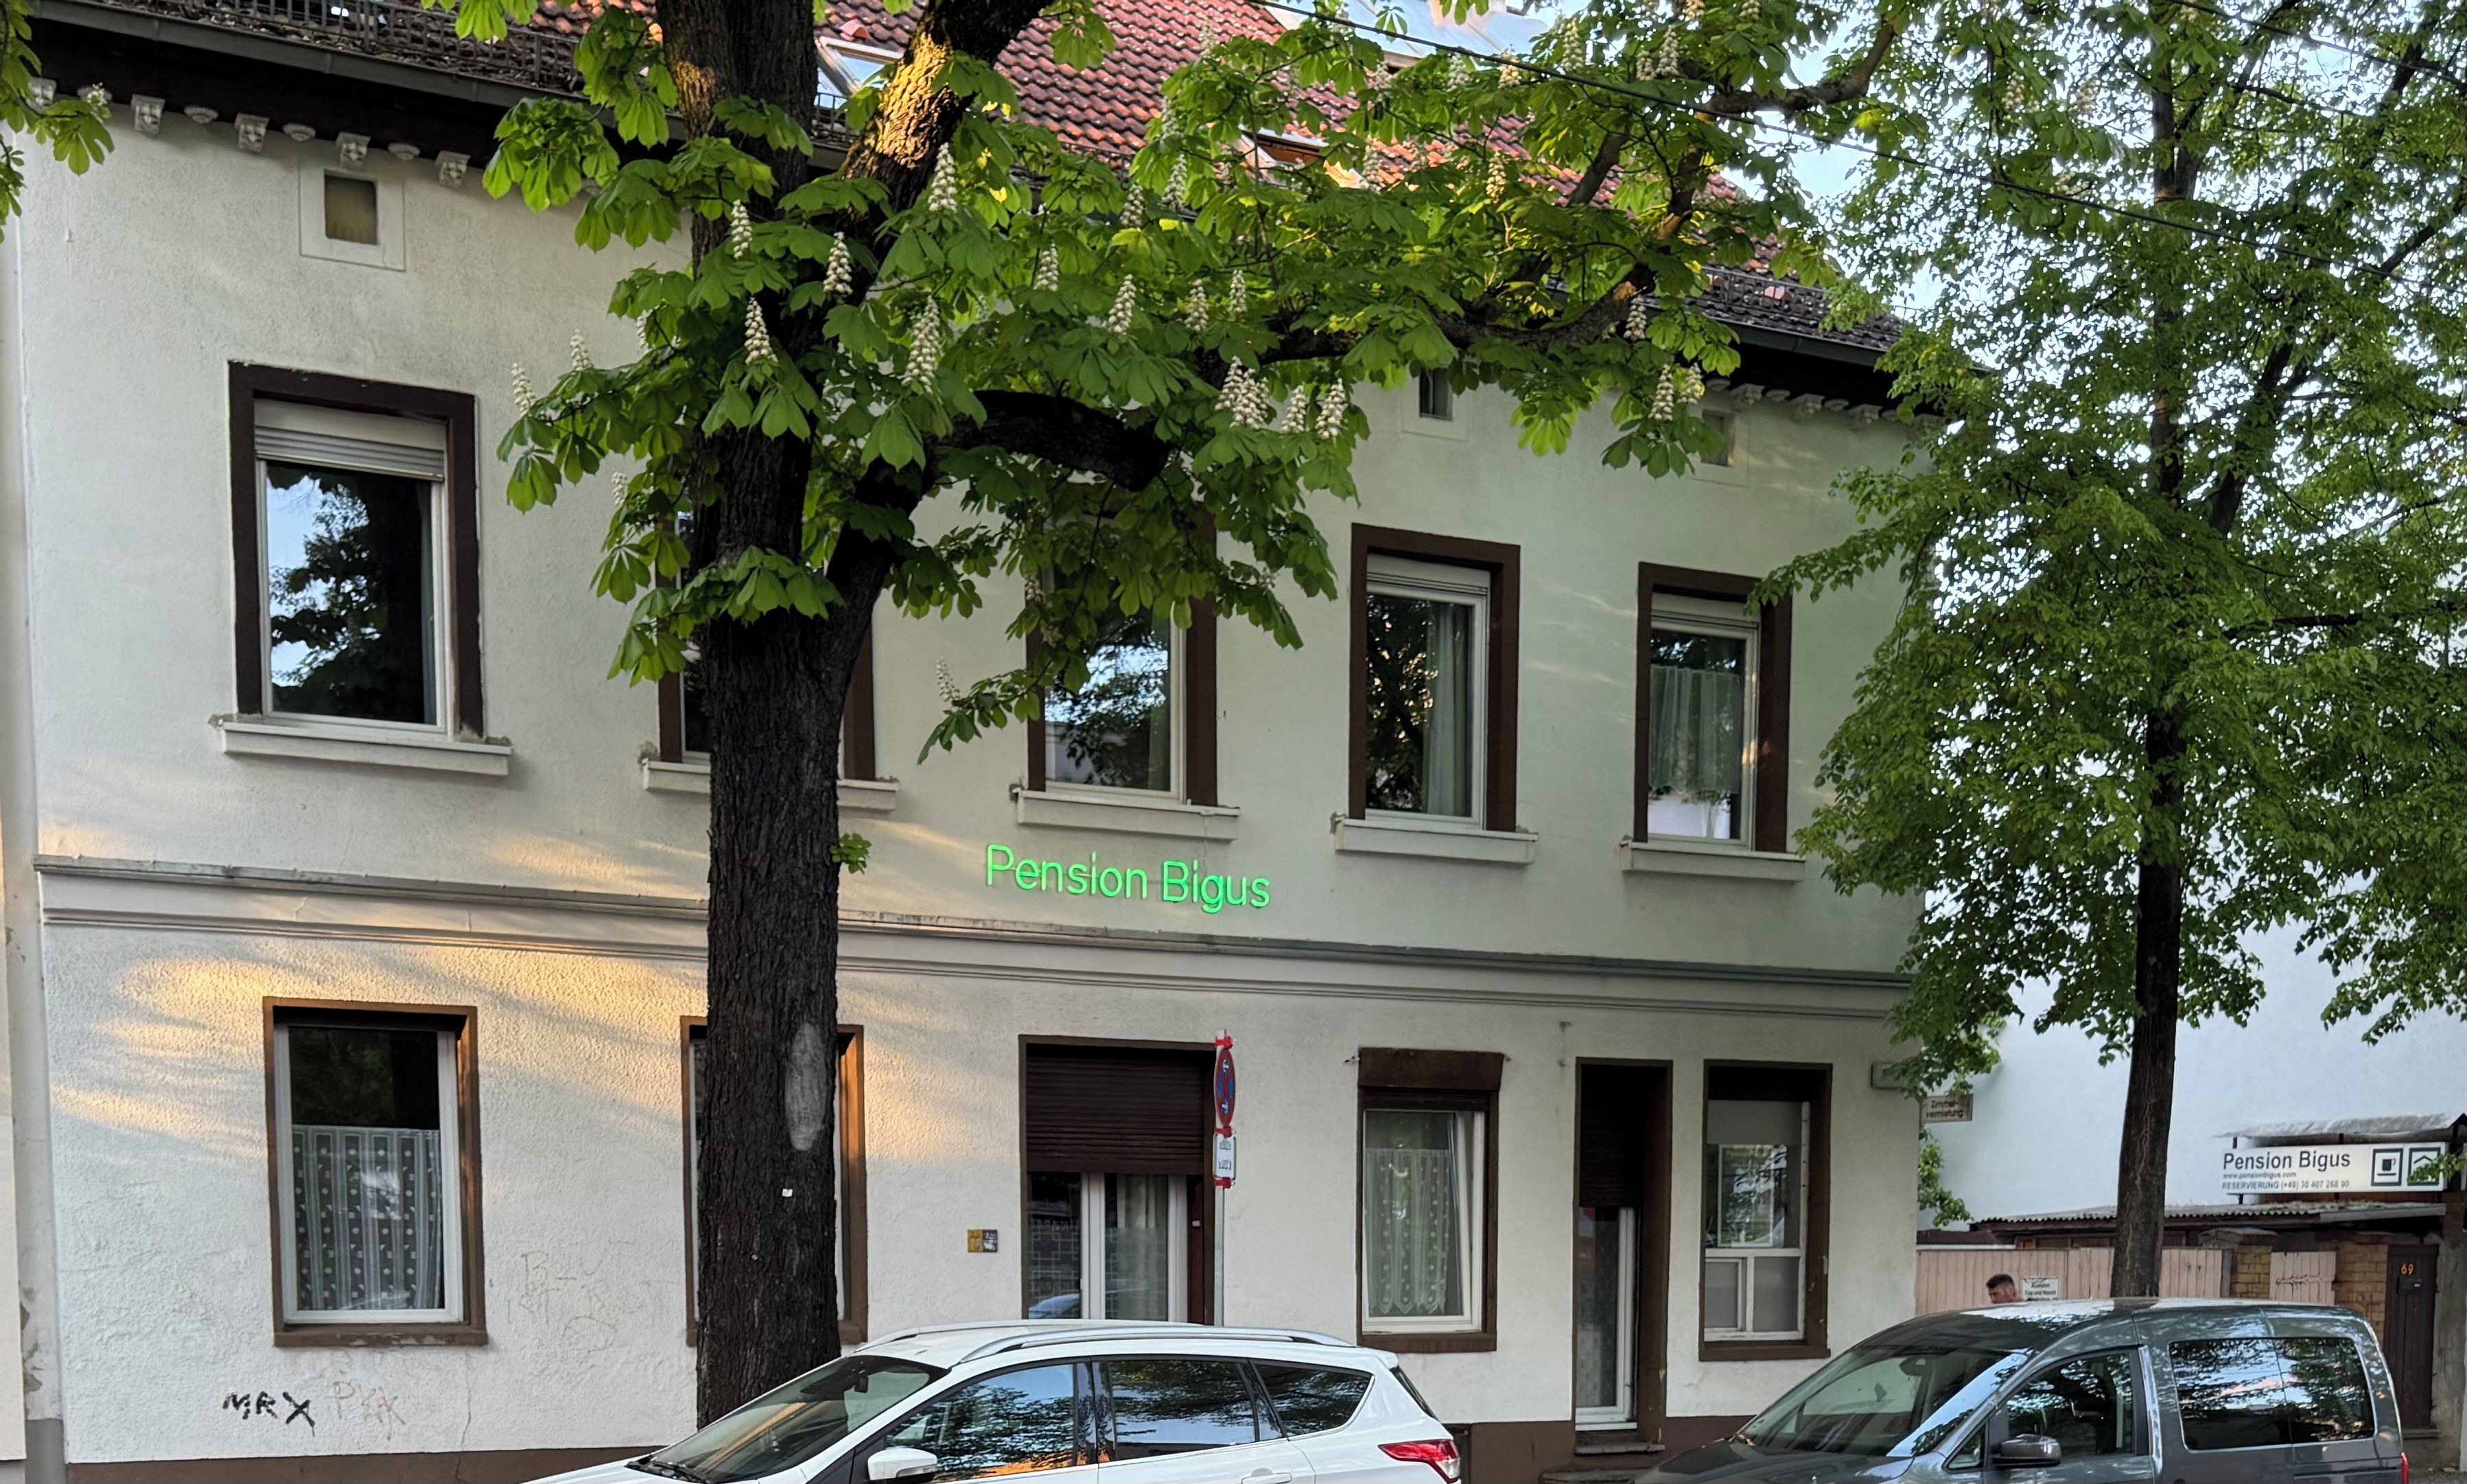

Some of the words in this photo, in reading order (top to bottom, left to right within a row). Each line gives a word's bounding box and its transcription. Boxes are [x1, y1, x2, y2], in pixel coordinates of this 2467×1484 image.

[986, 844, 1147, 899] Pension
[1163, 860, 1271, 913] Bigus
[2223, 1152, 2292, 1170] Pension
[2299, 1150, 2350, 1172] Bigus
[2222, 1181, 2279, 1190] RESERVIERUNG
[2281, 1181, 2299, 1191] (+49)
[2301, 1181, 2309, 1189] 30
[2400, 1263, 2413, 1275] 69
